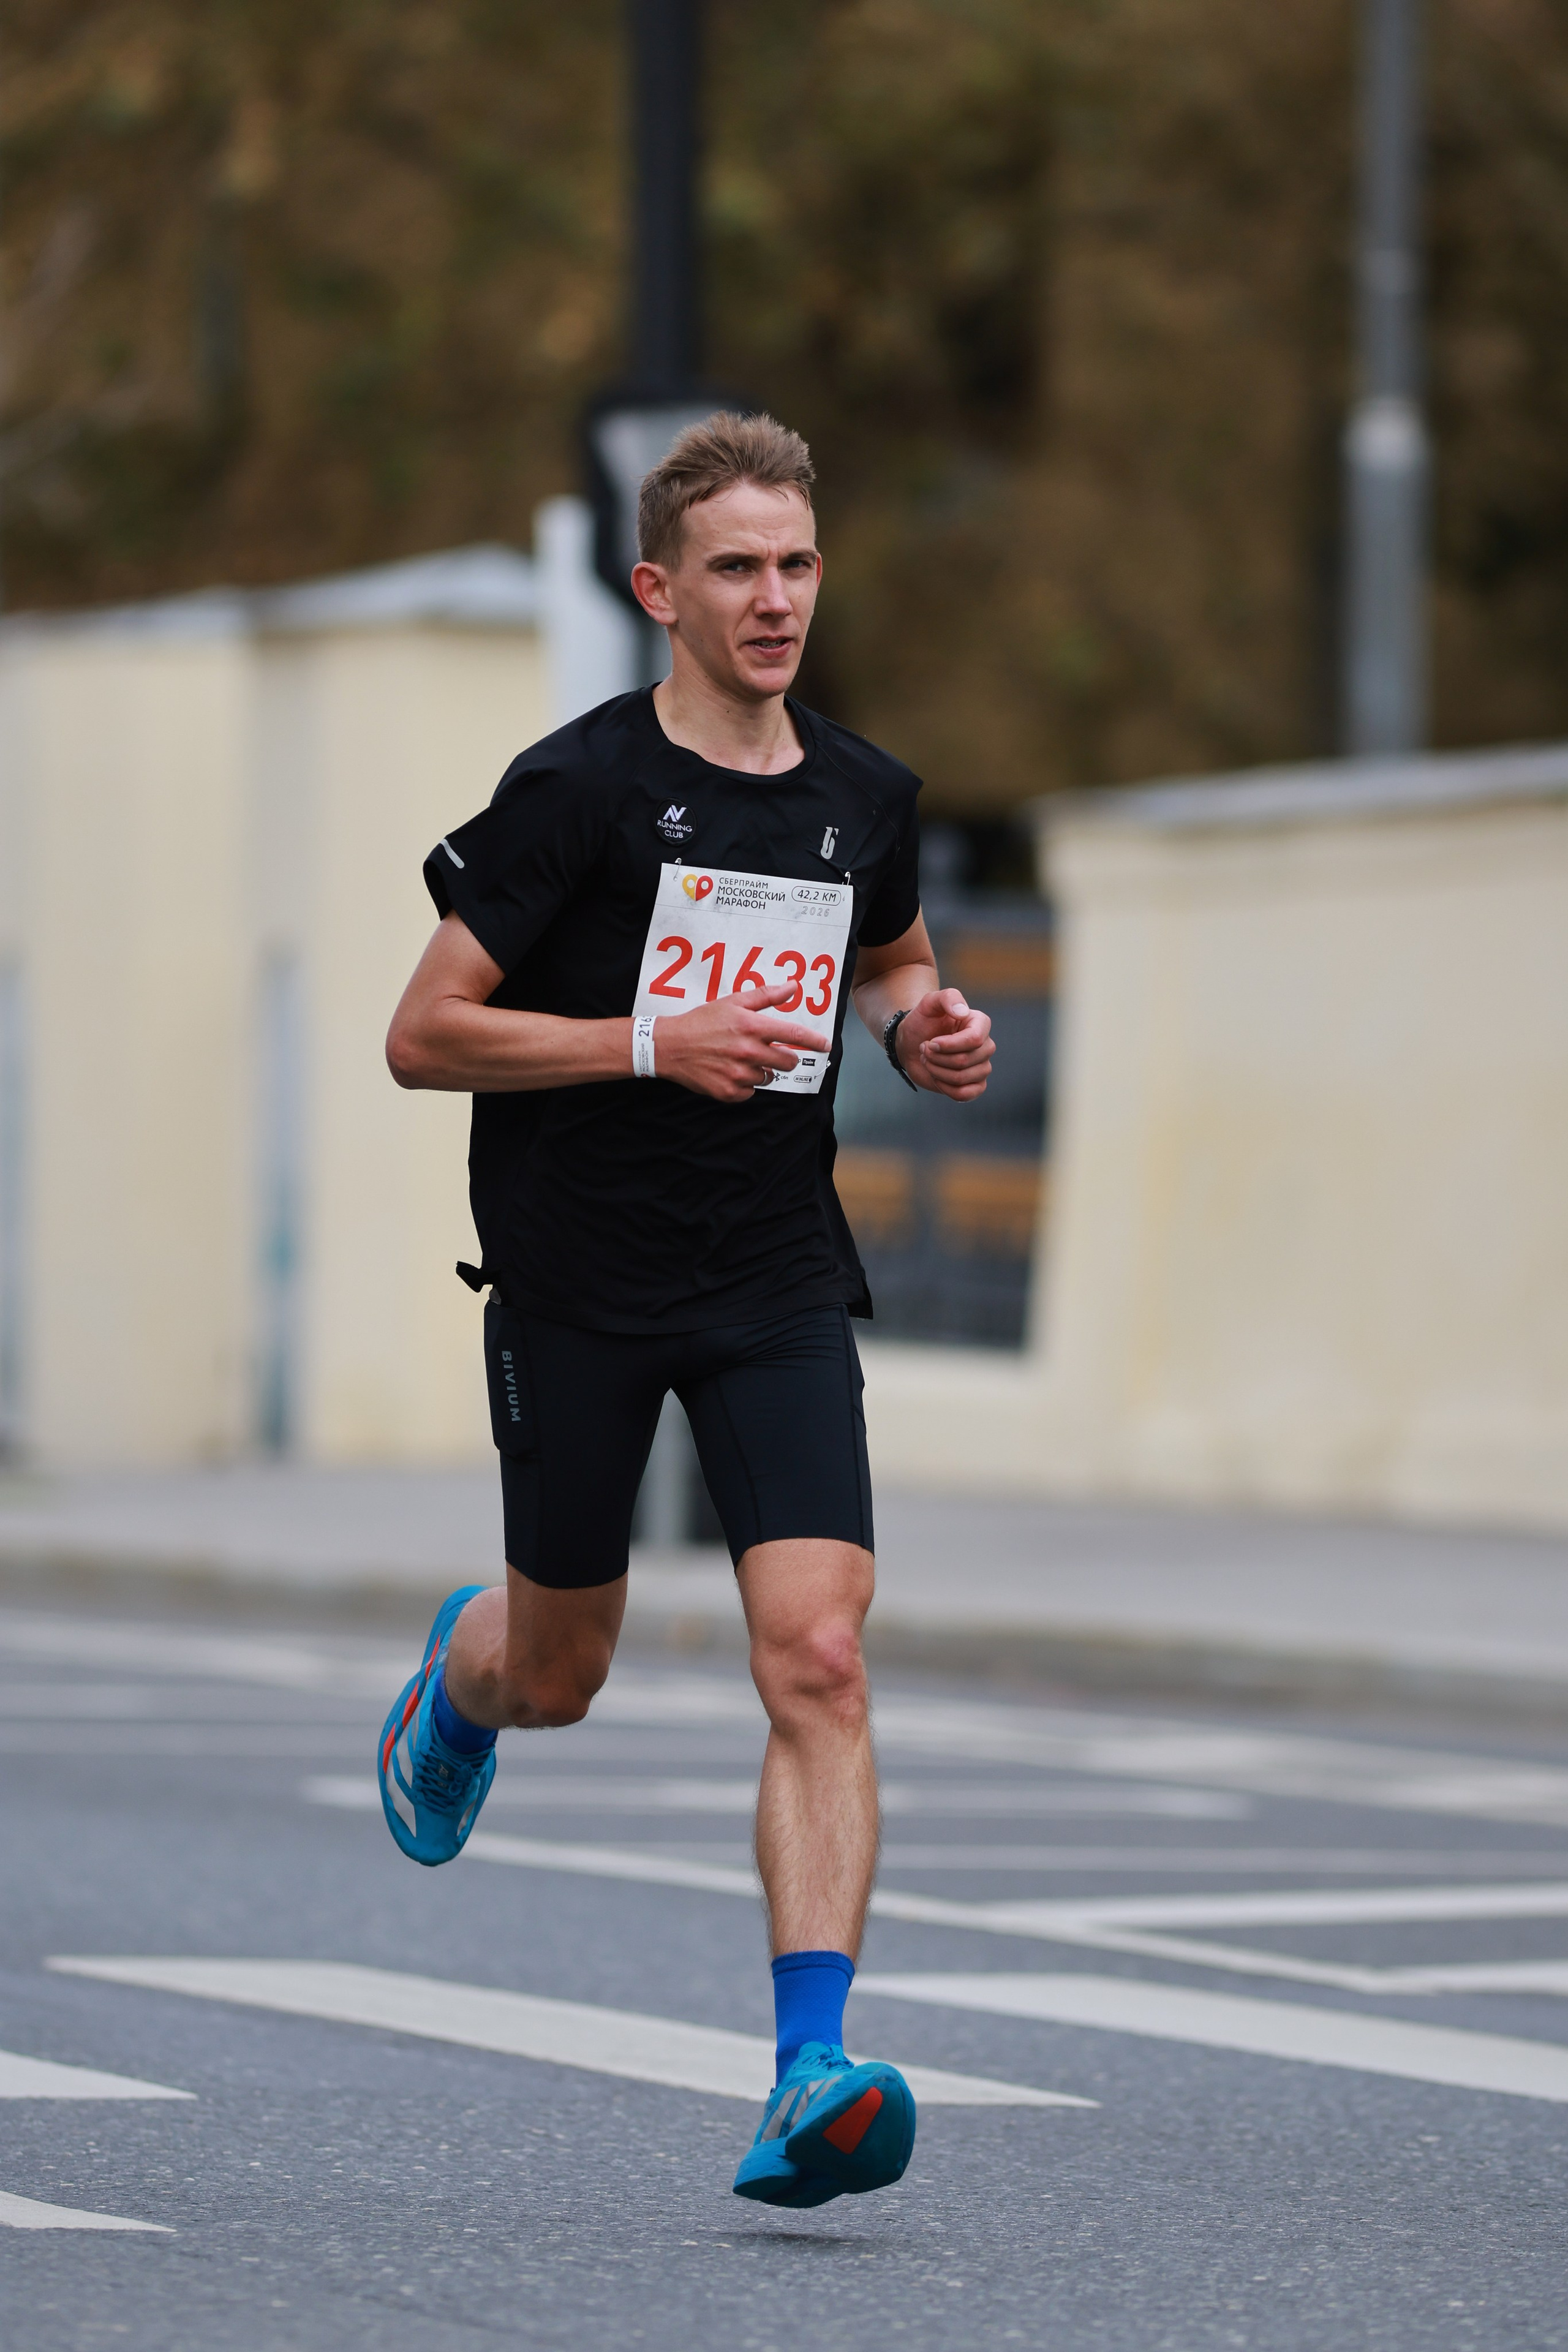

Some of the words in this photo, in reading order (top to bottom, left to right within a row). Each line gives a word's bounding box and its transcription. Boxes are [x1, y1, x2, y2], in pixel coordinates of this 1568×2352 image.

[657, 820, 692, 832] RUNNING
[719, 877, 769, 889] СБЕРПРАЙМ
[717, 886, 785, 902] МОСКОВСКИЙ
[797, 889, 820, 901] 42,2
[716, 896, 766, 910] МАРАФОН
[801, 905, 830, 917] 2026
[648, 935, 836, 1017] 21633
[638, 1016, 653, 1037] 216
[502, 1351, 521, 1422] BIVIUM
